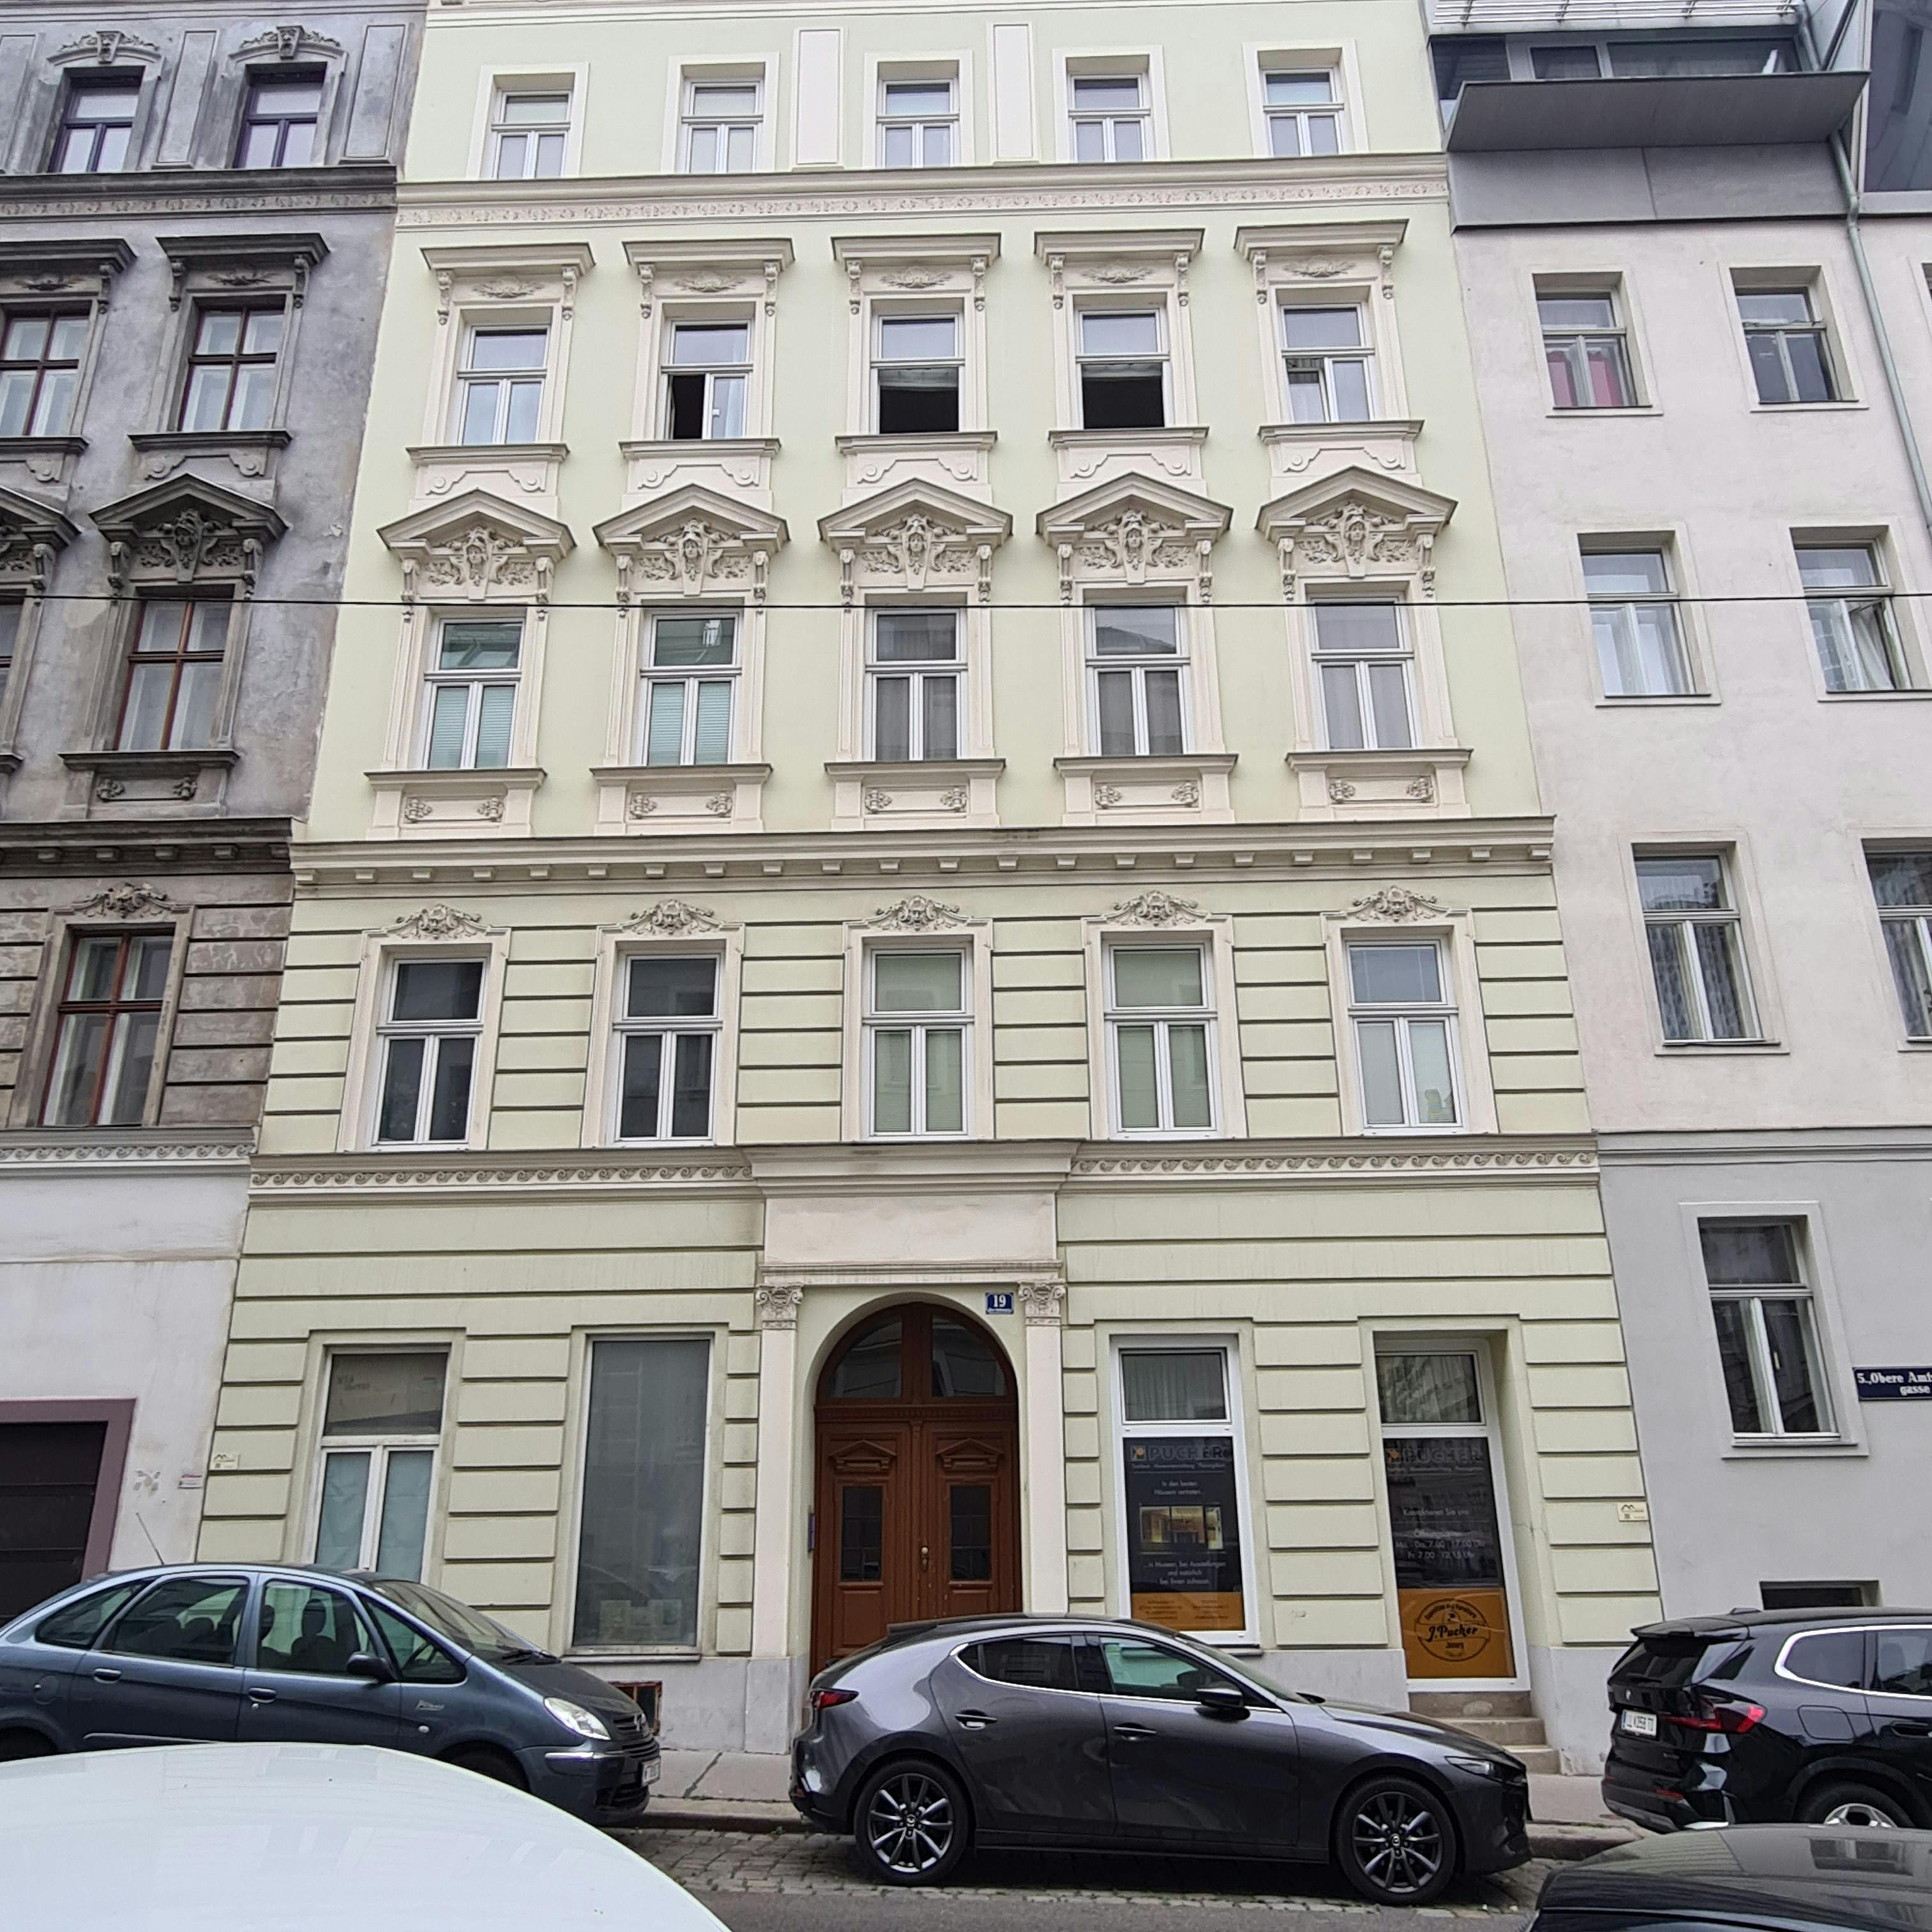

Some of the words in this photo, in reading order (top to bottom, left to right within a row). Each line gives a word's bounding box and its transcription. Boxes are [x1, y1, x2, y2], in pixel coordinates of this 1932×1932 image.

[993, 1295, 1006, 1308] 19
[1908, 1371, 1932, 1383] Amt
[1899, 1386, 1931, 1396] gasse
[1427, 1624, 1478, 1642] J.Pucher
